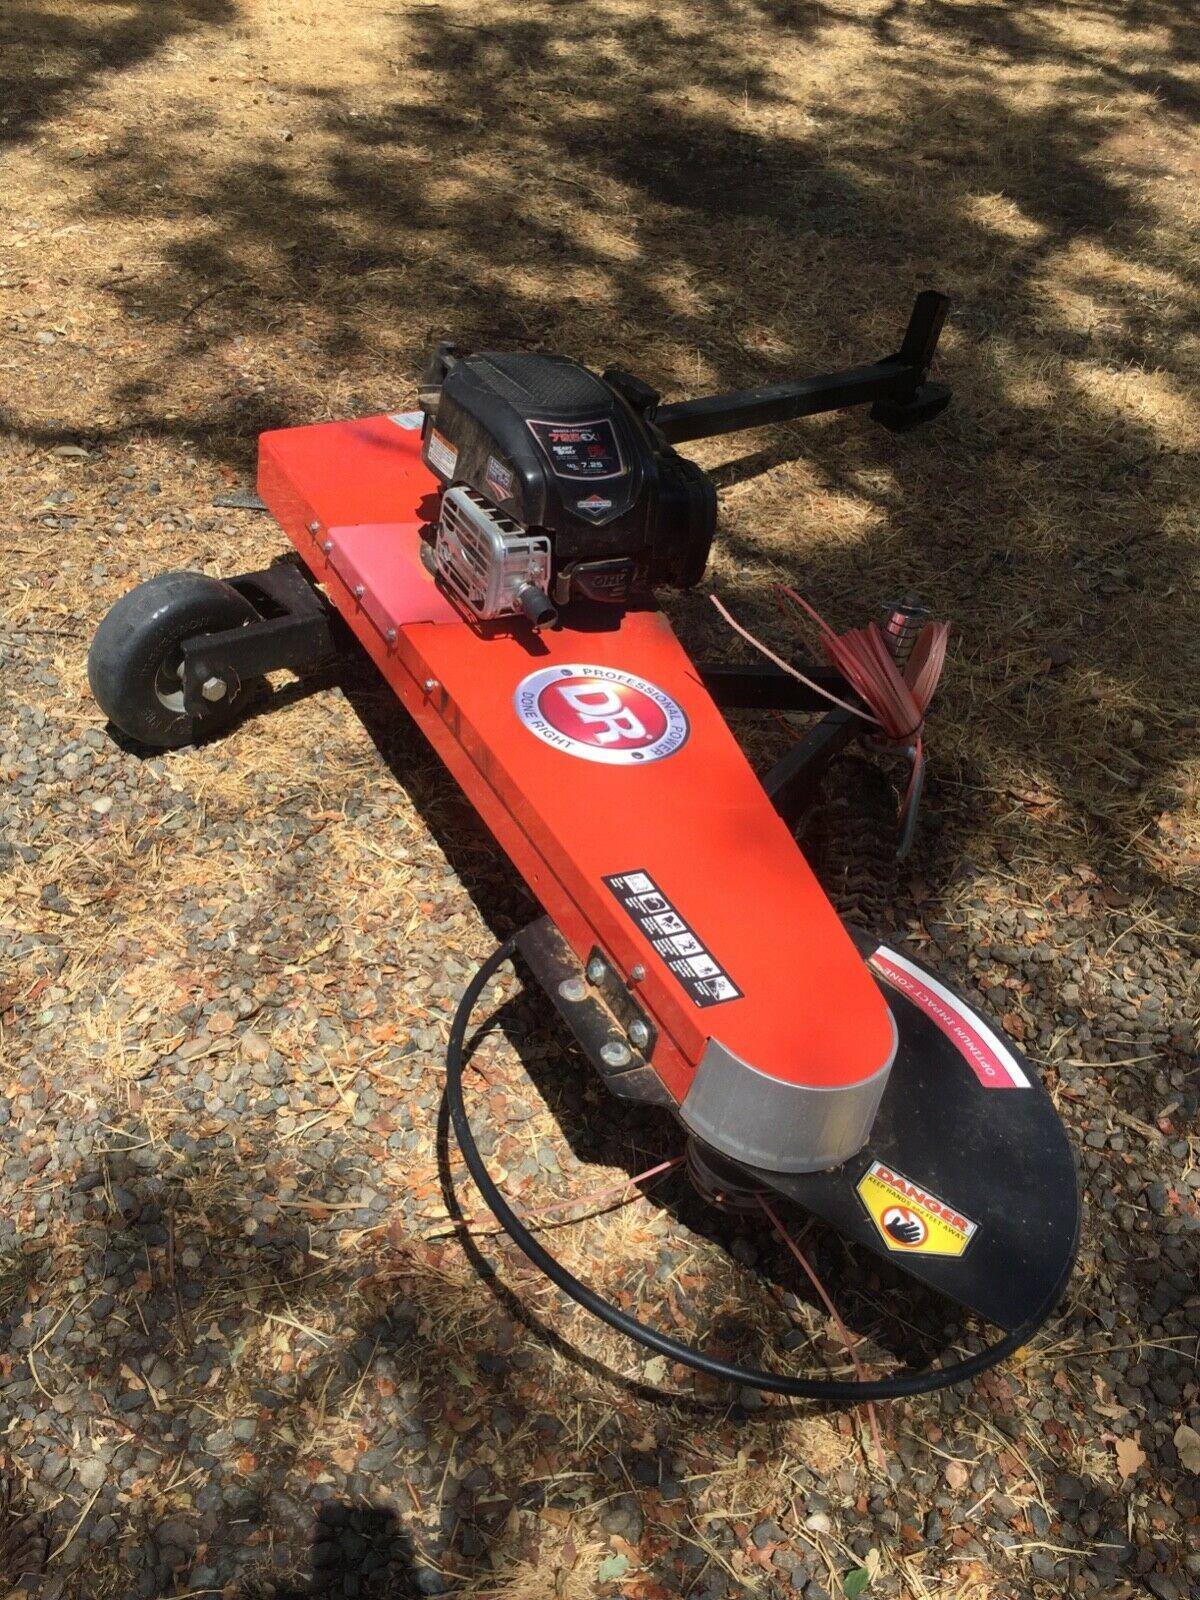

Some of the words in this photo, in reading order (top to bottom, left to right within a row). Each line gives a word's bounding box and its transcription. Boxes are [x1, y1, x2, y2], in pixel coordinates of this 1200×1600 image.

[521, 691, 538, 718] DONE
[532, 720, 576, 749] RIGHT
[556, 683, 647, 744] DR
[582, 668, 680, 721] PROFESSIONAL
[650, 725, 684, 756] POWER
[882, 966, 915, 991] ZONE
[914, 991, 955, 1026] IMPACT
[954, 1026, 996, 1076] OPTIMUM
[868, 1176, 886, 1190] KEEP
[886, 1187, 911, 1206] HANDS
[925, 1213, 942, 1226] FEET
[943, 1225, 966, 1242] AWAY
[875, 1167, 968, 1232] DANGER
